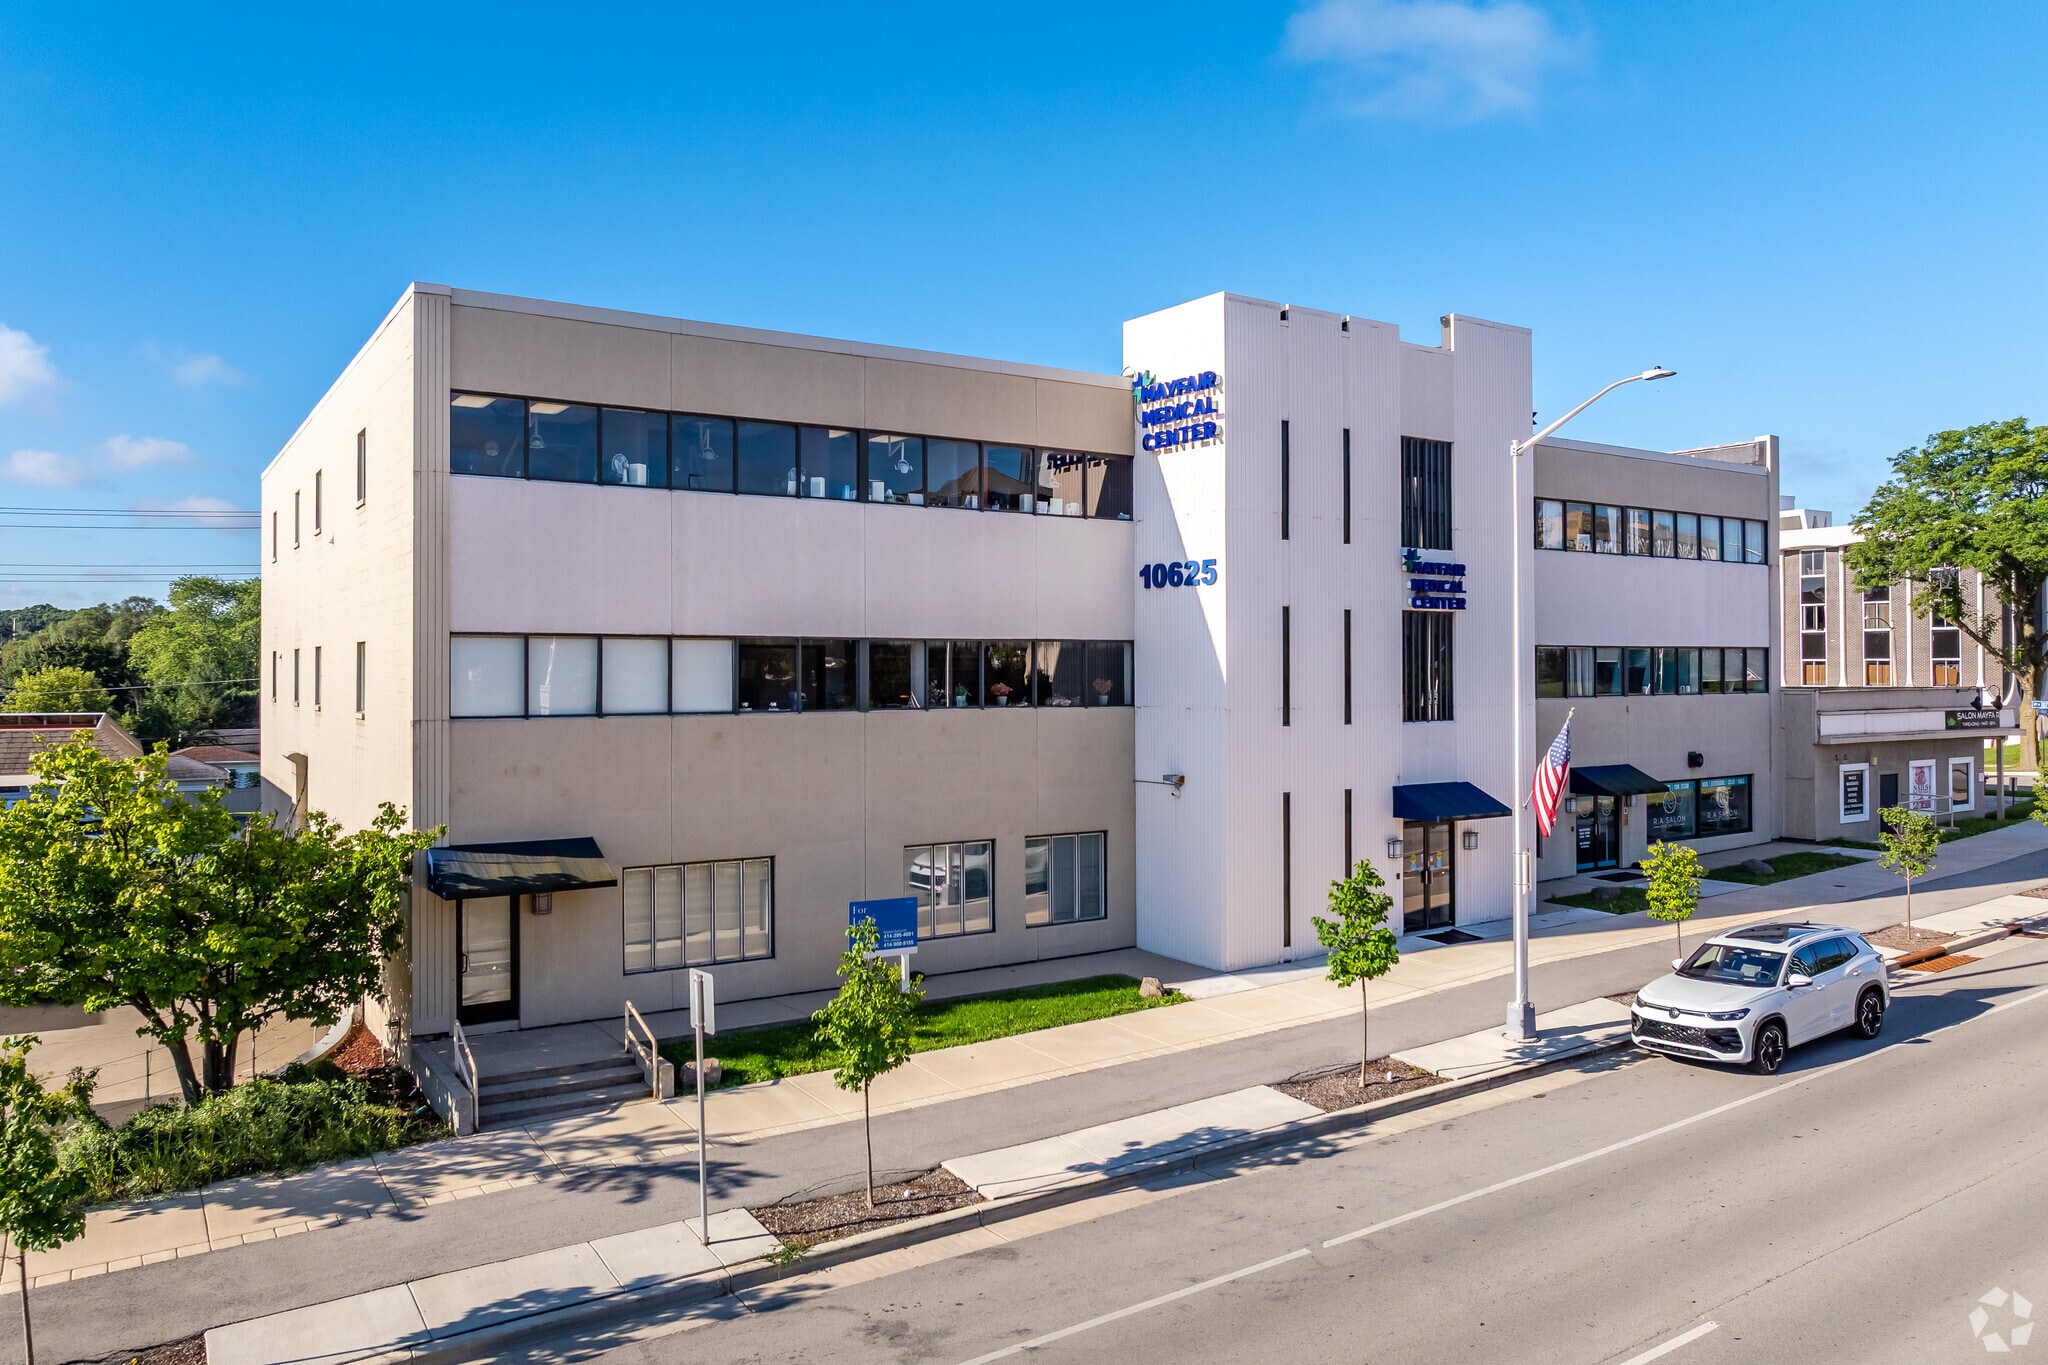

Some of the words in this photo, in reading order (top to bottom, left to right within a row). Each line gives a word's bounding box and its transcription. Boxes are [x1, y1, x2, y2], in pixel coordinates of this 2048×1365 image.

[1141, 371, 1217, 404] MAYFAIR
[1141, 397, 1217, 428] MEDICAL
[1142, 421, 1217, 451] CENTER
[1139, 559, 1218, 589] 10625
[1412, 561, 1467, 576] MAYFAIR
[1410, 579, 1467, 593] MEDICAL
[1411, 595, 1467, 610] CENTER
[1956, 711, 1977, 720] SALON
[1977, 710, 2001, 719] MAYFAR
[1665, 815, 1686, 824] SALON
[852, 905, 868, 915] For
